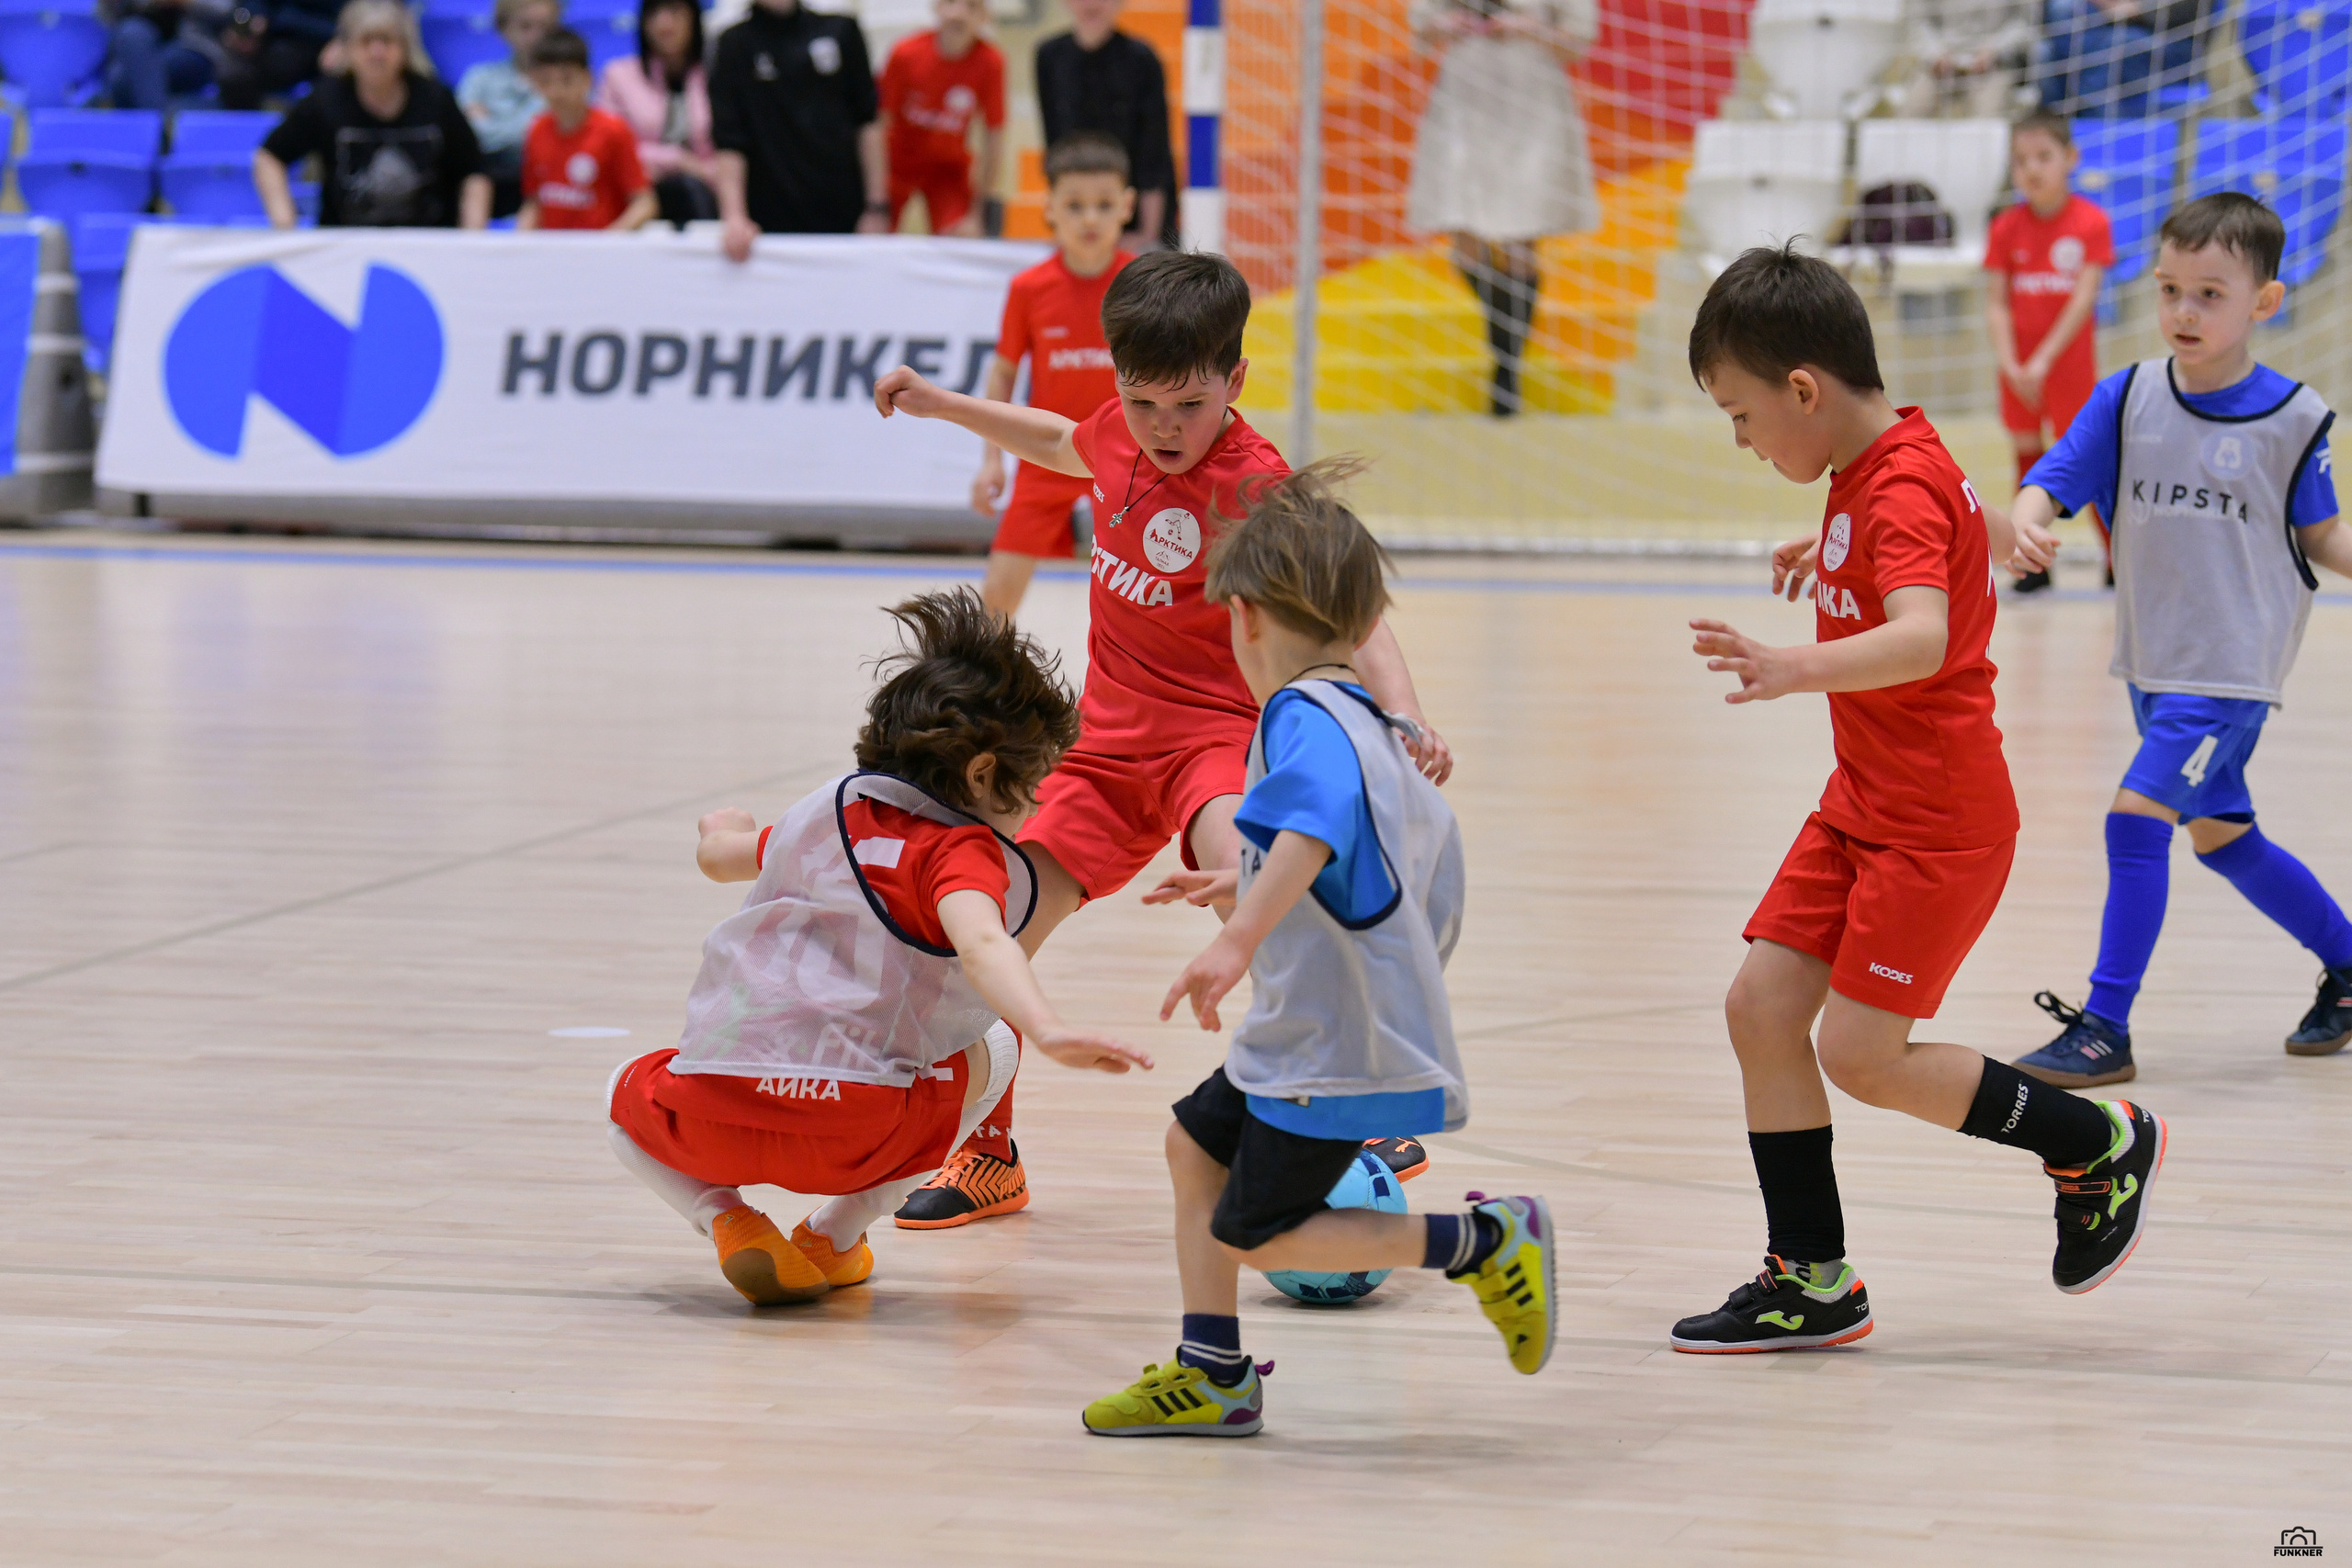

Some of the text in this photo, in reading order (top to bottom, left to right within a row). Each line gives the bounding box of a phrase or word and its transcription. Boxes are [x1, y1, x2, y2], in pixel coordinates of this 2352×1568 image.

[503, 331, 1000, 398] НОРНИКЕЛ
[2132, 479, 2248, 524] KIPSTA
[1149, 528, 1193, 559] АРКТИКА
[2180, 735, 2219, 787] 4
[1240, 847, 1261, 876] TA
[1869, 962, 1914, 985] KODES
[2000, 1081, 2029, 1134] TORRES
[999, 1166, 1026, 1201] PUM
